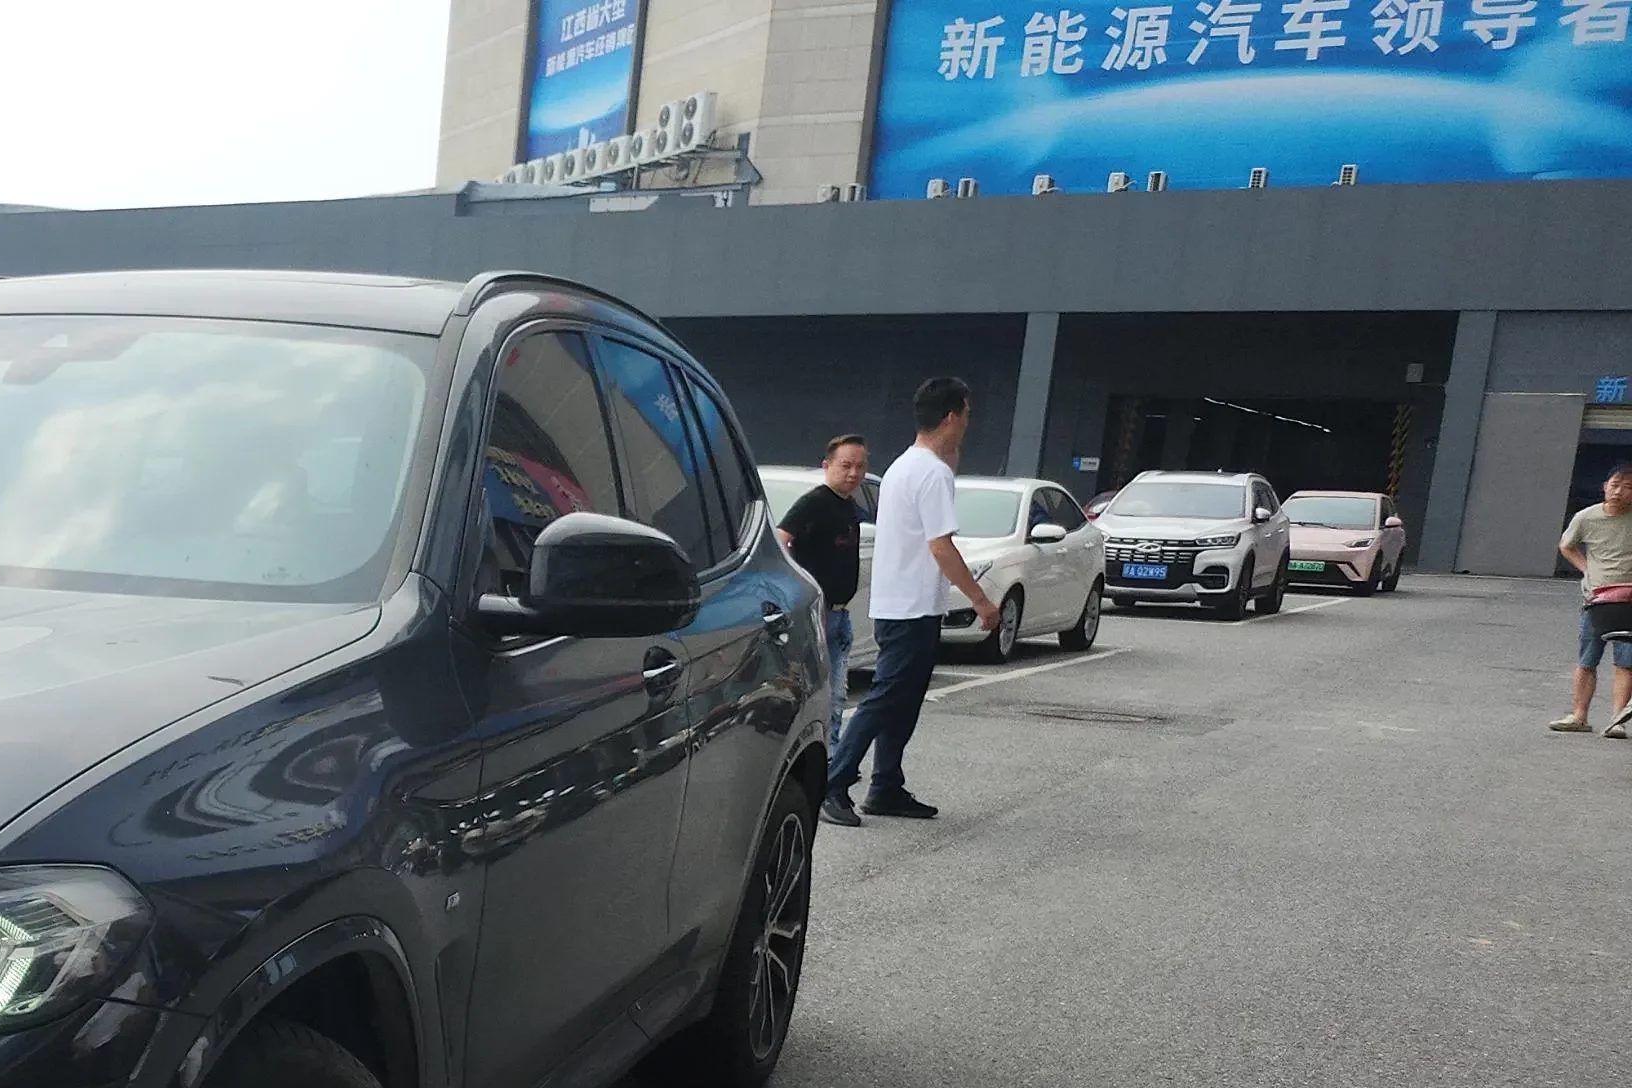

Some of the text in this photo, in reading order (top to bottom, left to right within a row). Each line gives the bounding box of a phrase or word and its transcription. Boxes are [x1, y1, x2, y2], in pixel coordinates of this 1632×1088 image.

[937, 0, 1630, 81] 新能源汽车领导者
